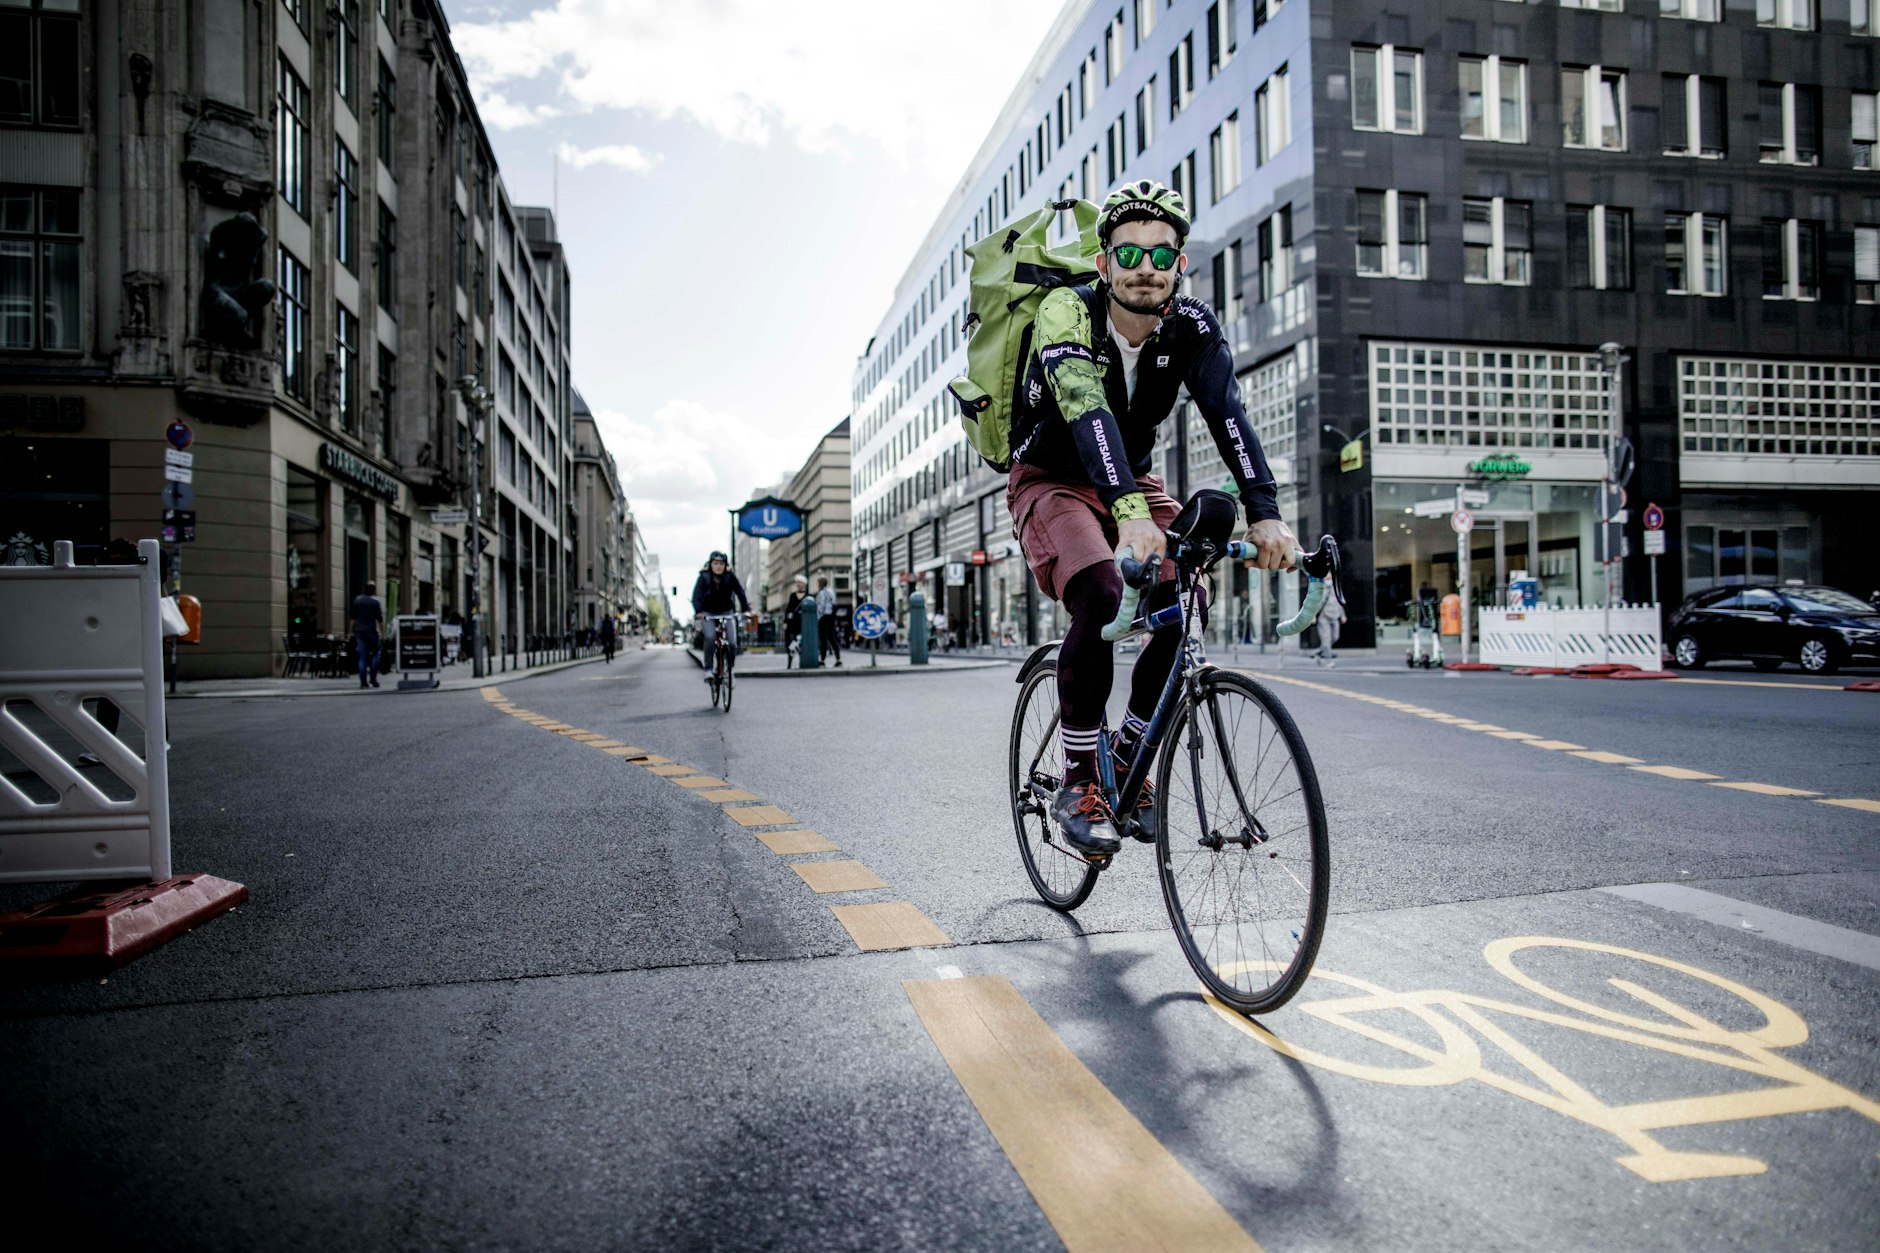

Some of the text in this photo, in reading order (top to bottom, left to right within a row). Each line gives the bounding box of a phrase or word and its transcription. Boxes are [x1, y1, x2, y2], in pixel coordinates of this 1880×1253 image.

[1110, 202, 1164, 222] STADTSALAT
[1225, 417, 1256, 479] BIEHLER
[326, 443, 375, 488] STARBUCKS
[1470, 459, 1533, 473] VORWERK
[763, 508, 777, 527] U
[751, 525, 790, 535] Stadtmitte
